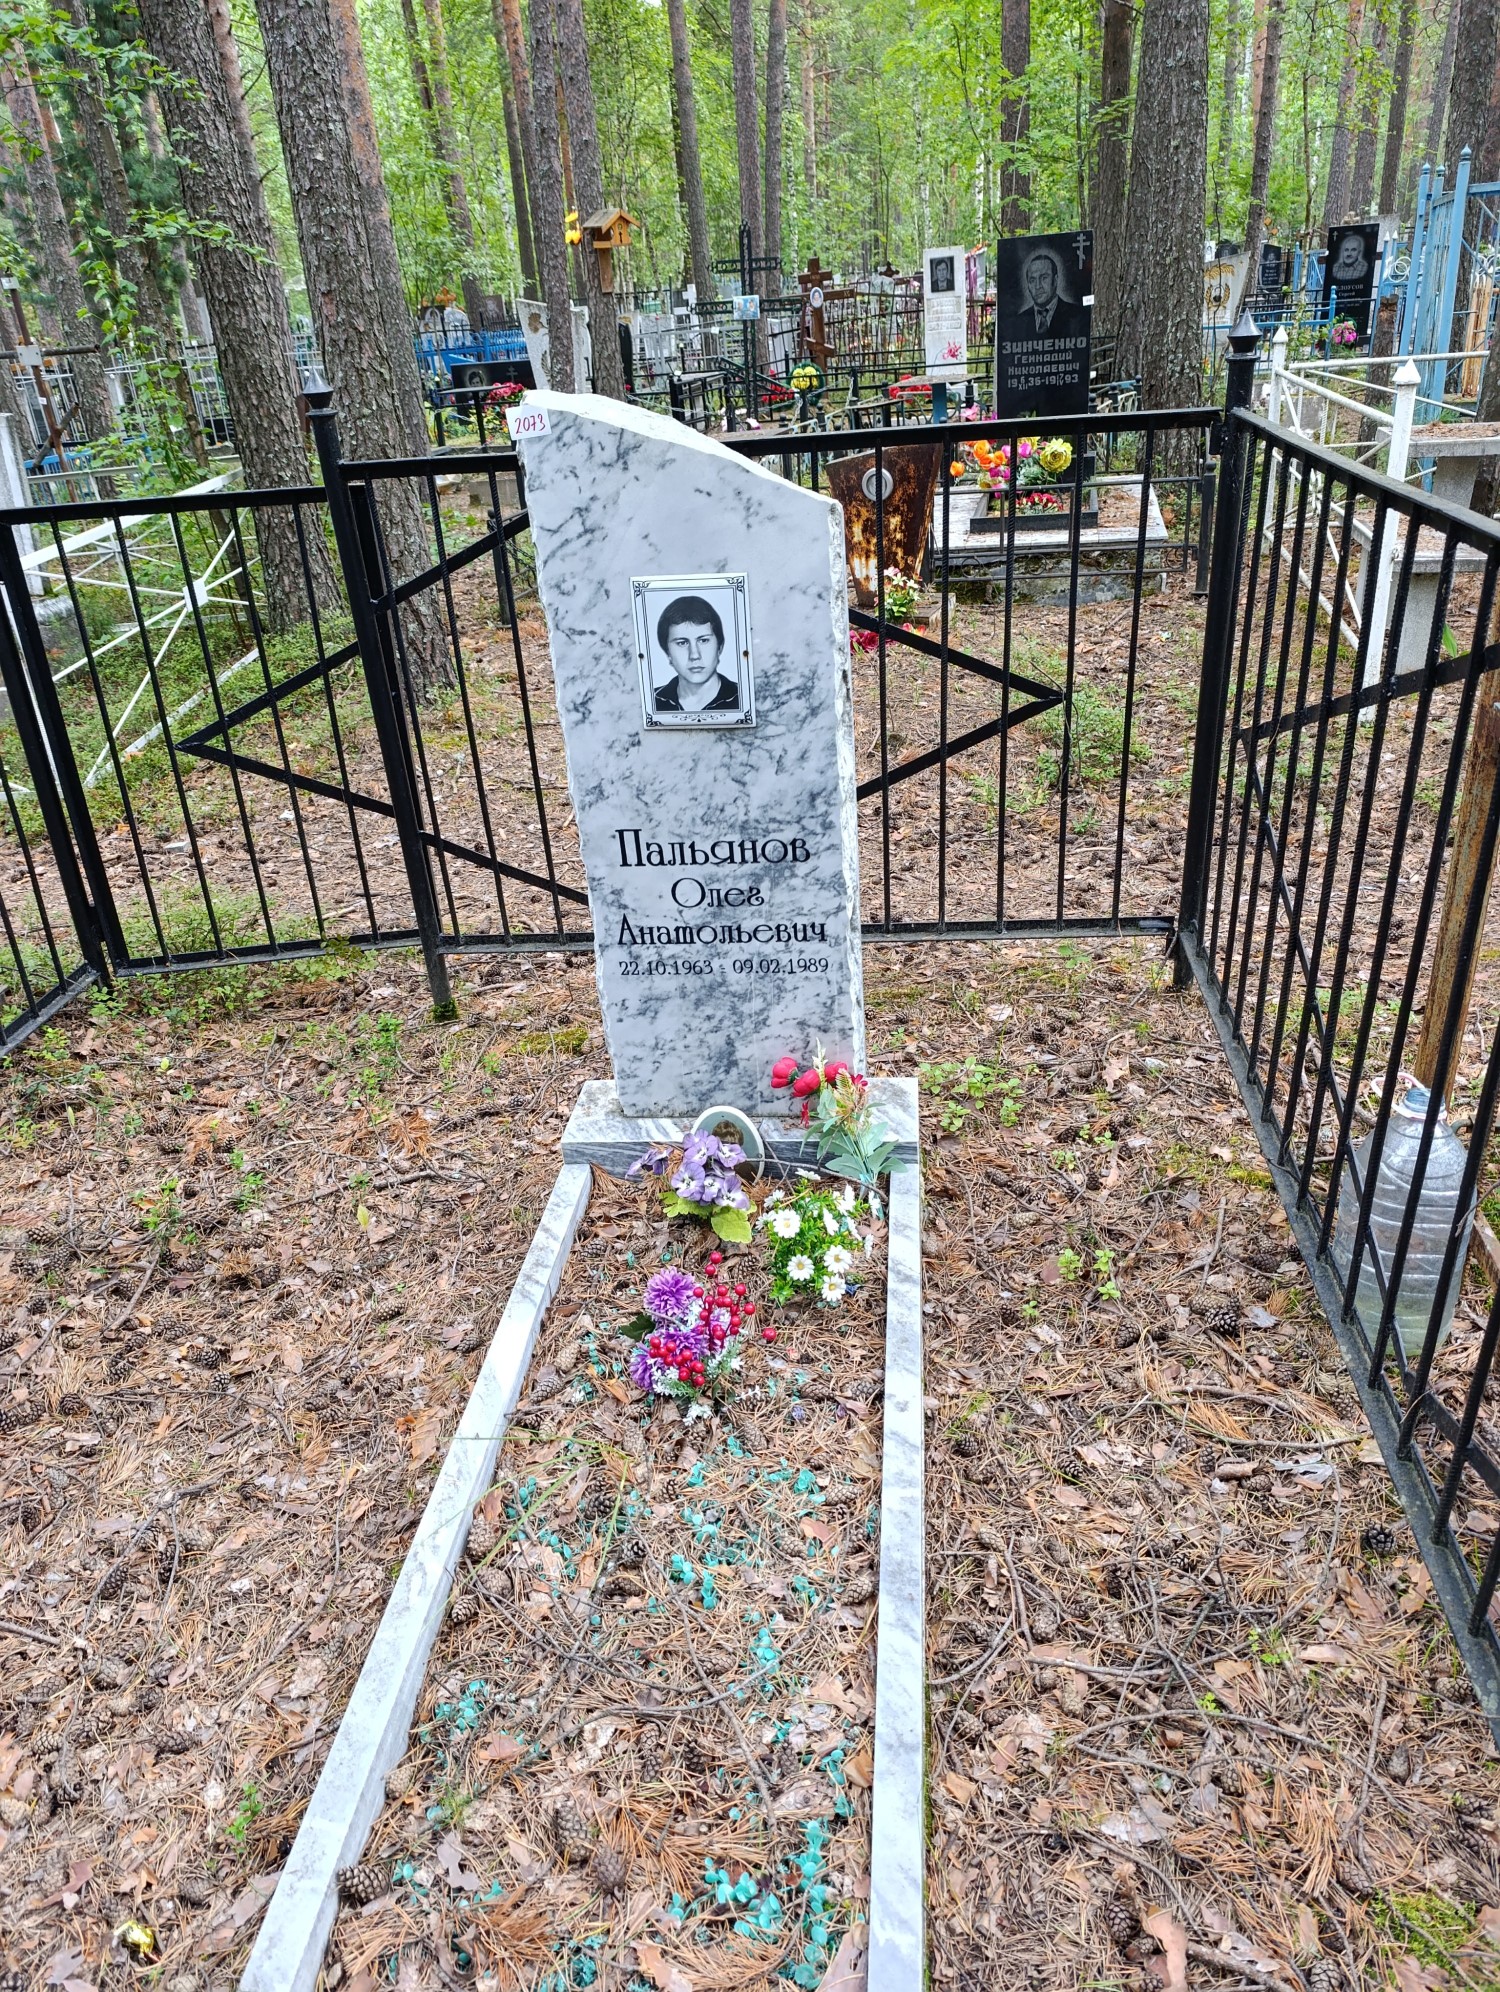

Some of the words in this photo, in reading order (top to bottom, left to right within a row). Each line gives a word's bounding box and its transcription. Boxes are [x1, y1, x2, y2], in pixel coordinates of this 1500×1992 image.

[1002, 336, 1087, 354] ЗИНЧЕНКО
[514, 413, 546, 435] 2073
[614, 828, 811, 868] Пальянов
[670, 877, 765, 908] Олег
[617, 912, 829, 945] Анатольевич
[618, 959, 714, 976] 22.10.1963
[732, 957, 829, 975] 09.02.1989
